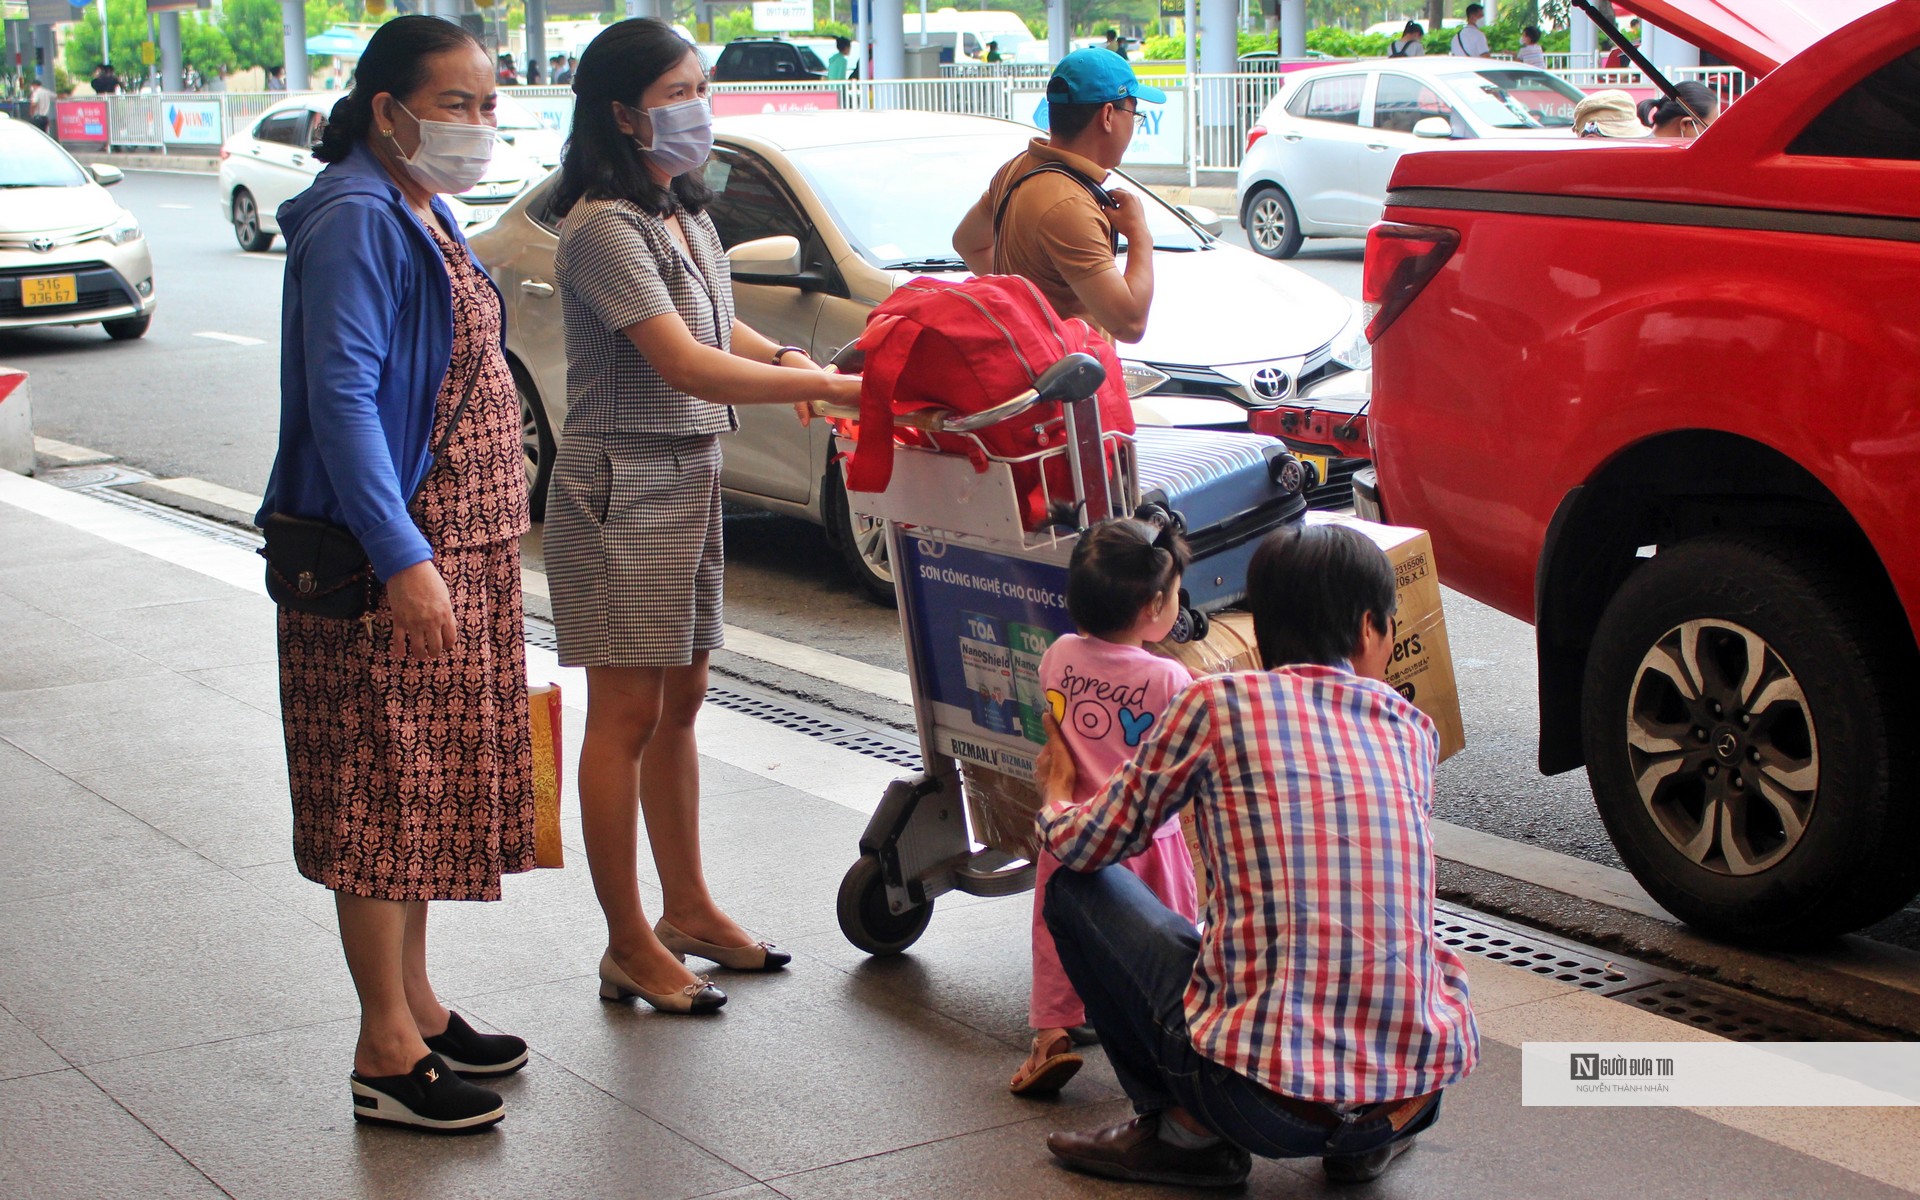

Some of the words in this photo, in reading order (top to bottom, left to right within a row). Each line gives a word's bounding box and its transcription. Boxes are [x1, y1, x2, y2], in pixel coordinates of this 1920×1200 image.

[37, 279, 60, 291] 51G
[29, 290, 70, 305] 336.67
[1419, 566, 1425, 577] 4
[919, 564, 941, 581] SƠN
[942, 567, 971, 588] CÔNG
[972, 575, 1001, 599] NGHỆ
[1002, 582, 1025, 599] CHO
[1027, 587, 1057, 609] CUỘC
[967, 619, 997, 642] TOA
[1020, 631, 1048, 652] TOA
[962, 643, 1011, 669] NanoShield
[1061, 665, 1150, 710] Spread
[1001, 752, 1032, 771] BIZMAN
